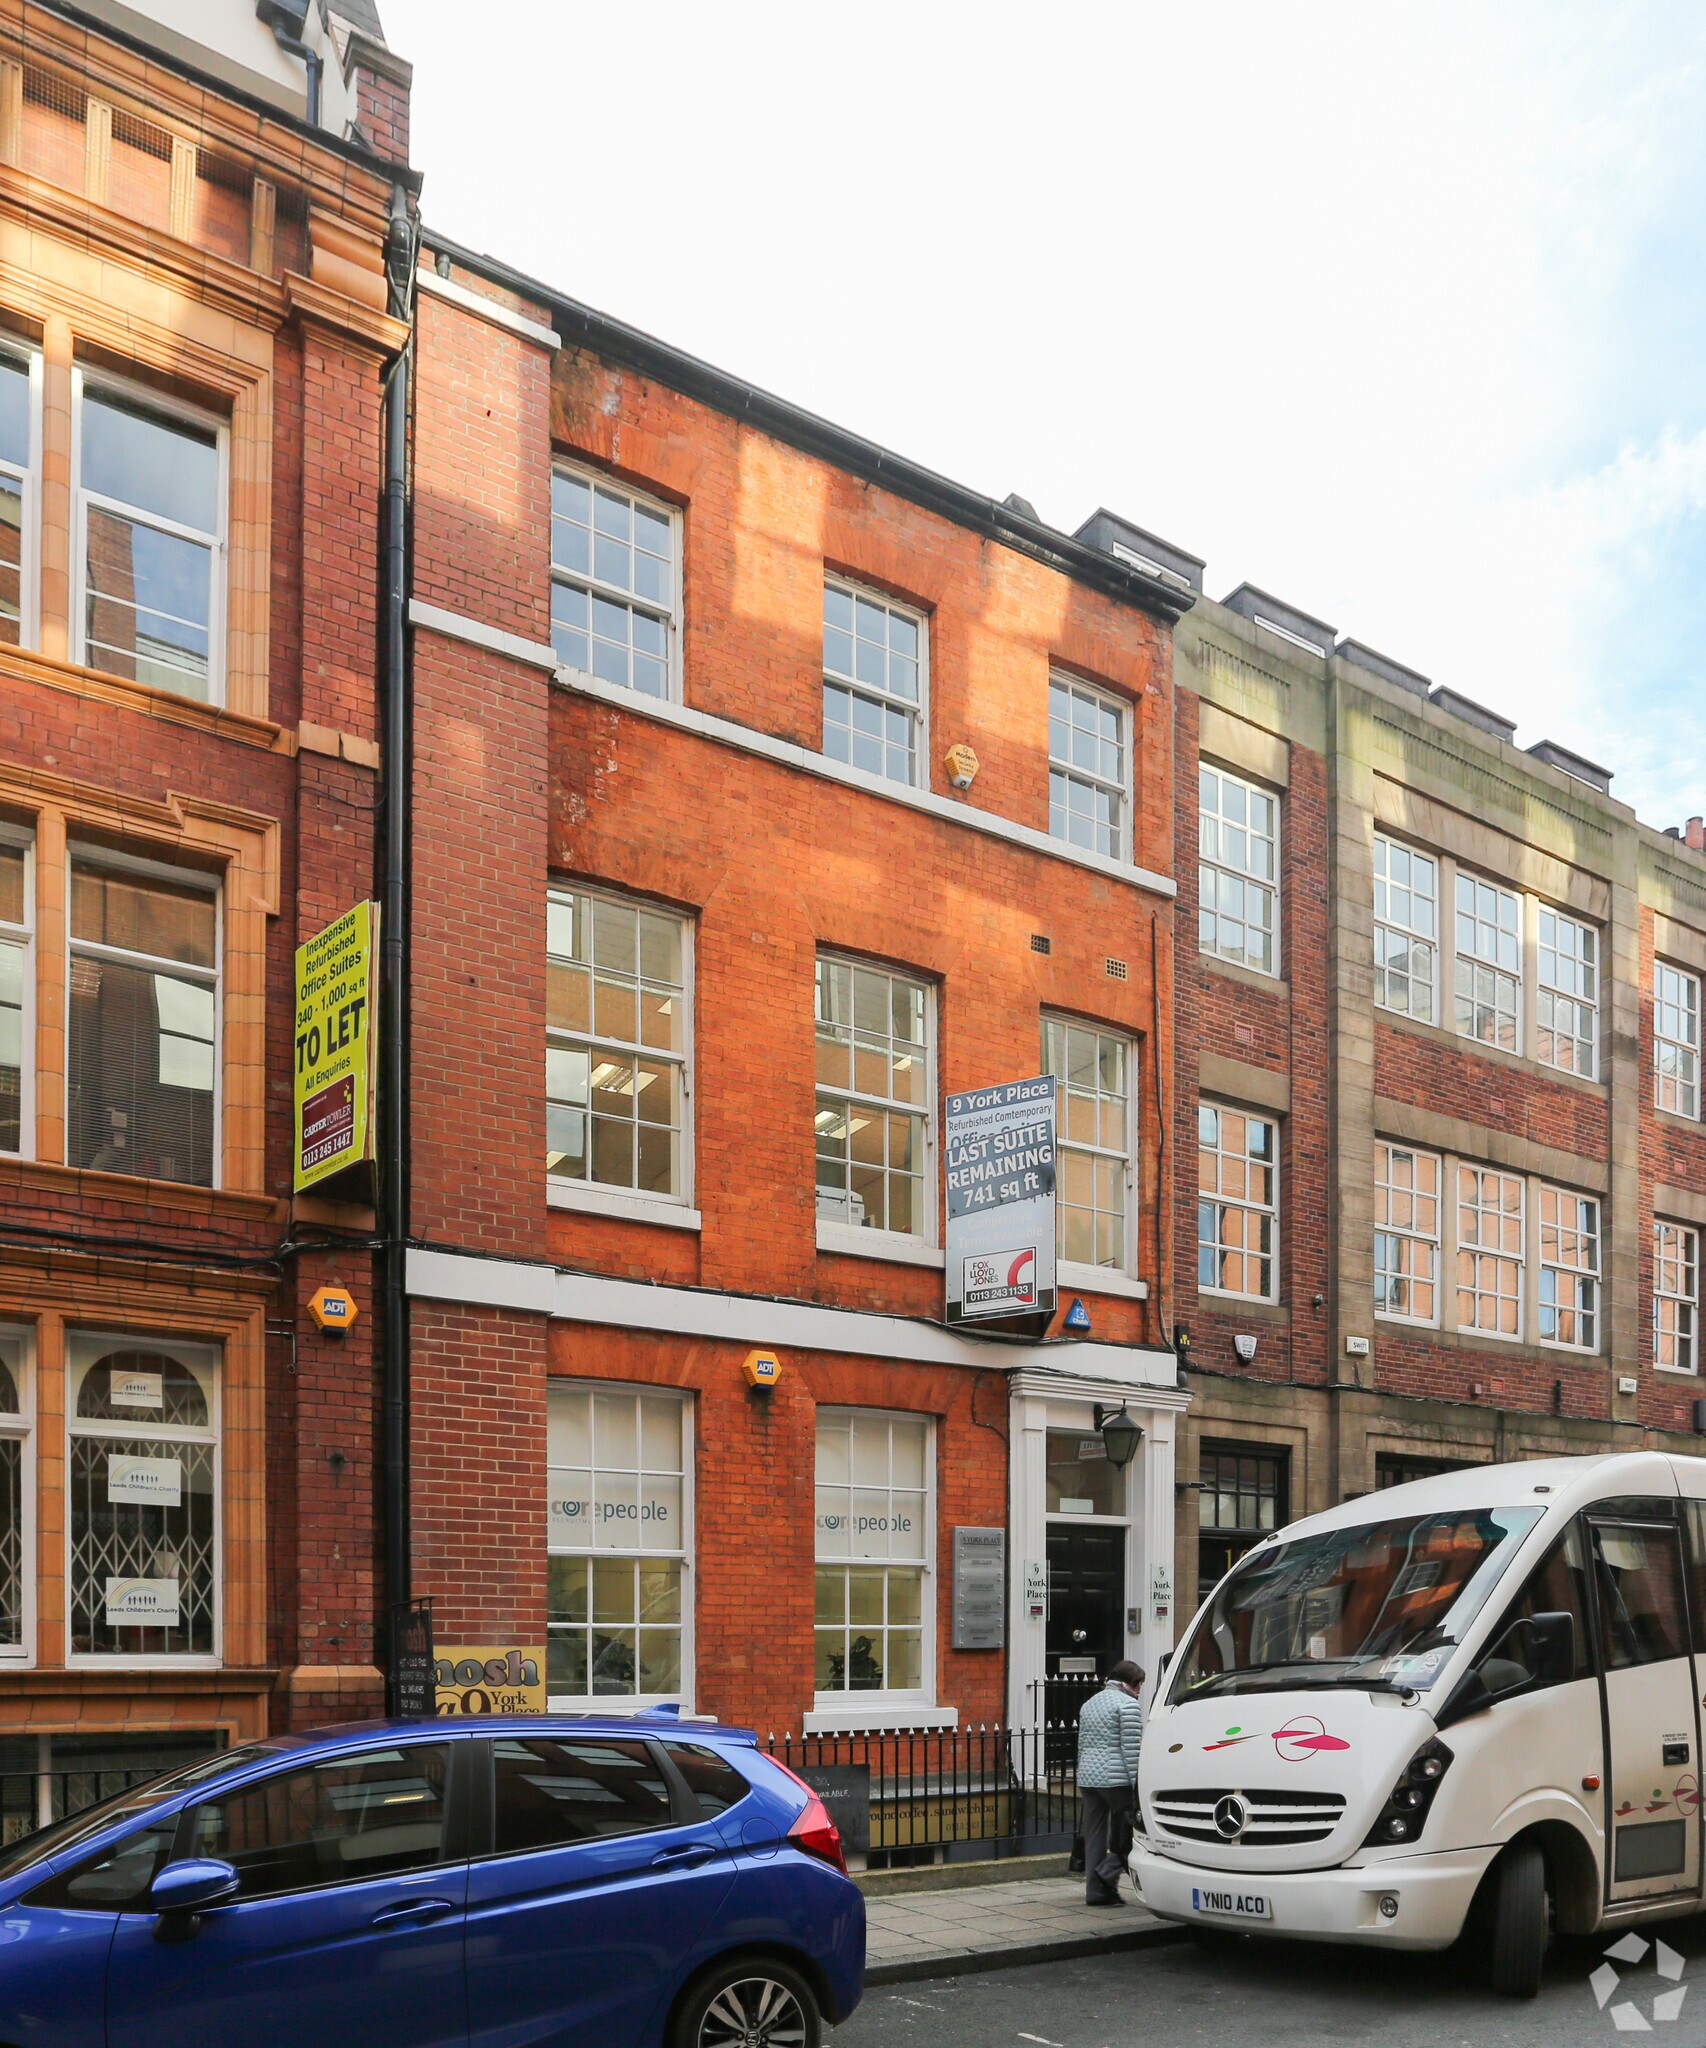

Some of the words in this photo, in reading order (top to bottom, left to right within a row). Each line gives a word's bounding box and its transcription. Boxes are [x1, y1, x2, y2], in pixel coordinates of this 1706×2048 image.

[306, 914, 355, 957] Inexpensive
[305, 929, 356, 977] Refurbished
[301, 973, 327, 1001] Office
[329, 950, 361, 981] Suites
[297, 1005, 313, 1028] 340
[321, 982, 347, 1011] 1,000
[348, 983, 357, 994] sq
[359, 976, 365, 988] ft
[296, 1025, 321, 1073] TO
[326, 996, 365, 1056] LET
[304, 1075, 315, 1092] All
[316, 1056, 351, 1084] Enquiries
[952, 1098, 962, 1113] 9
[966, 1090, 1002, 1110] York
[1006, 1082, 1049, 1102] Place
[948, 1115, 993, 1132] Refurbished
[303, 1148, 319, 1168] 0113
[319, 1141, 332, 1158] 245
[333, 1131, 352, 1151] 1447
[947, 1140, 989, 1168] LAST
[993, 1122, 1048, 1154] SUITE
[947, 1144, 1052, 1190] REMAINING
[963, 1184, 996, 1208] 741
[1000, 1180, 1020, 1199] sq
[1023, 1171, 1040, 1191] ft
[970, 1267, 995, 1279] LLOYD
[972, 1260, 989, 1270] FOX
[973, 1275, 999, 1286] JONES
[970, 1290, 990, 1301] 0113
[991, 1287, 1008, 1299] 243
[1009, 1284, 1029, 1296] 1133
[324, 1302, 347, 1313] ADT
[757, 1363, 774, 1373] ADT
[1034, 1566, 1040, 1575] 9
[1160, 1570, 1165, 1578] 9
[1028, 1578, 1047, 1588] York
[1154, 1580, 1171, 1589] York
[1027, 1589, 1047, 1599] Place
[1153, 1591, 1172, 1600] Place
[490, 1691, 528, 1705] York
[1203, 1891, 1232, 1910] YN10
[1236, 1895, 1264, 1914] ACO
